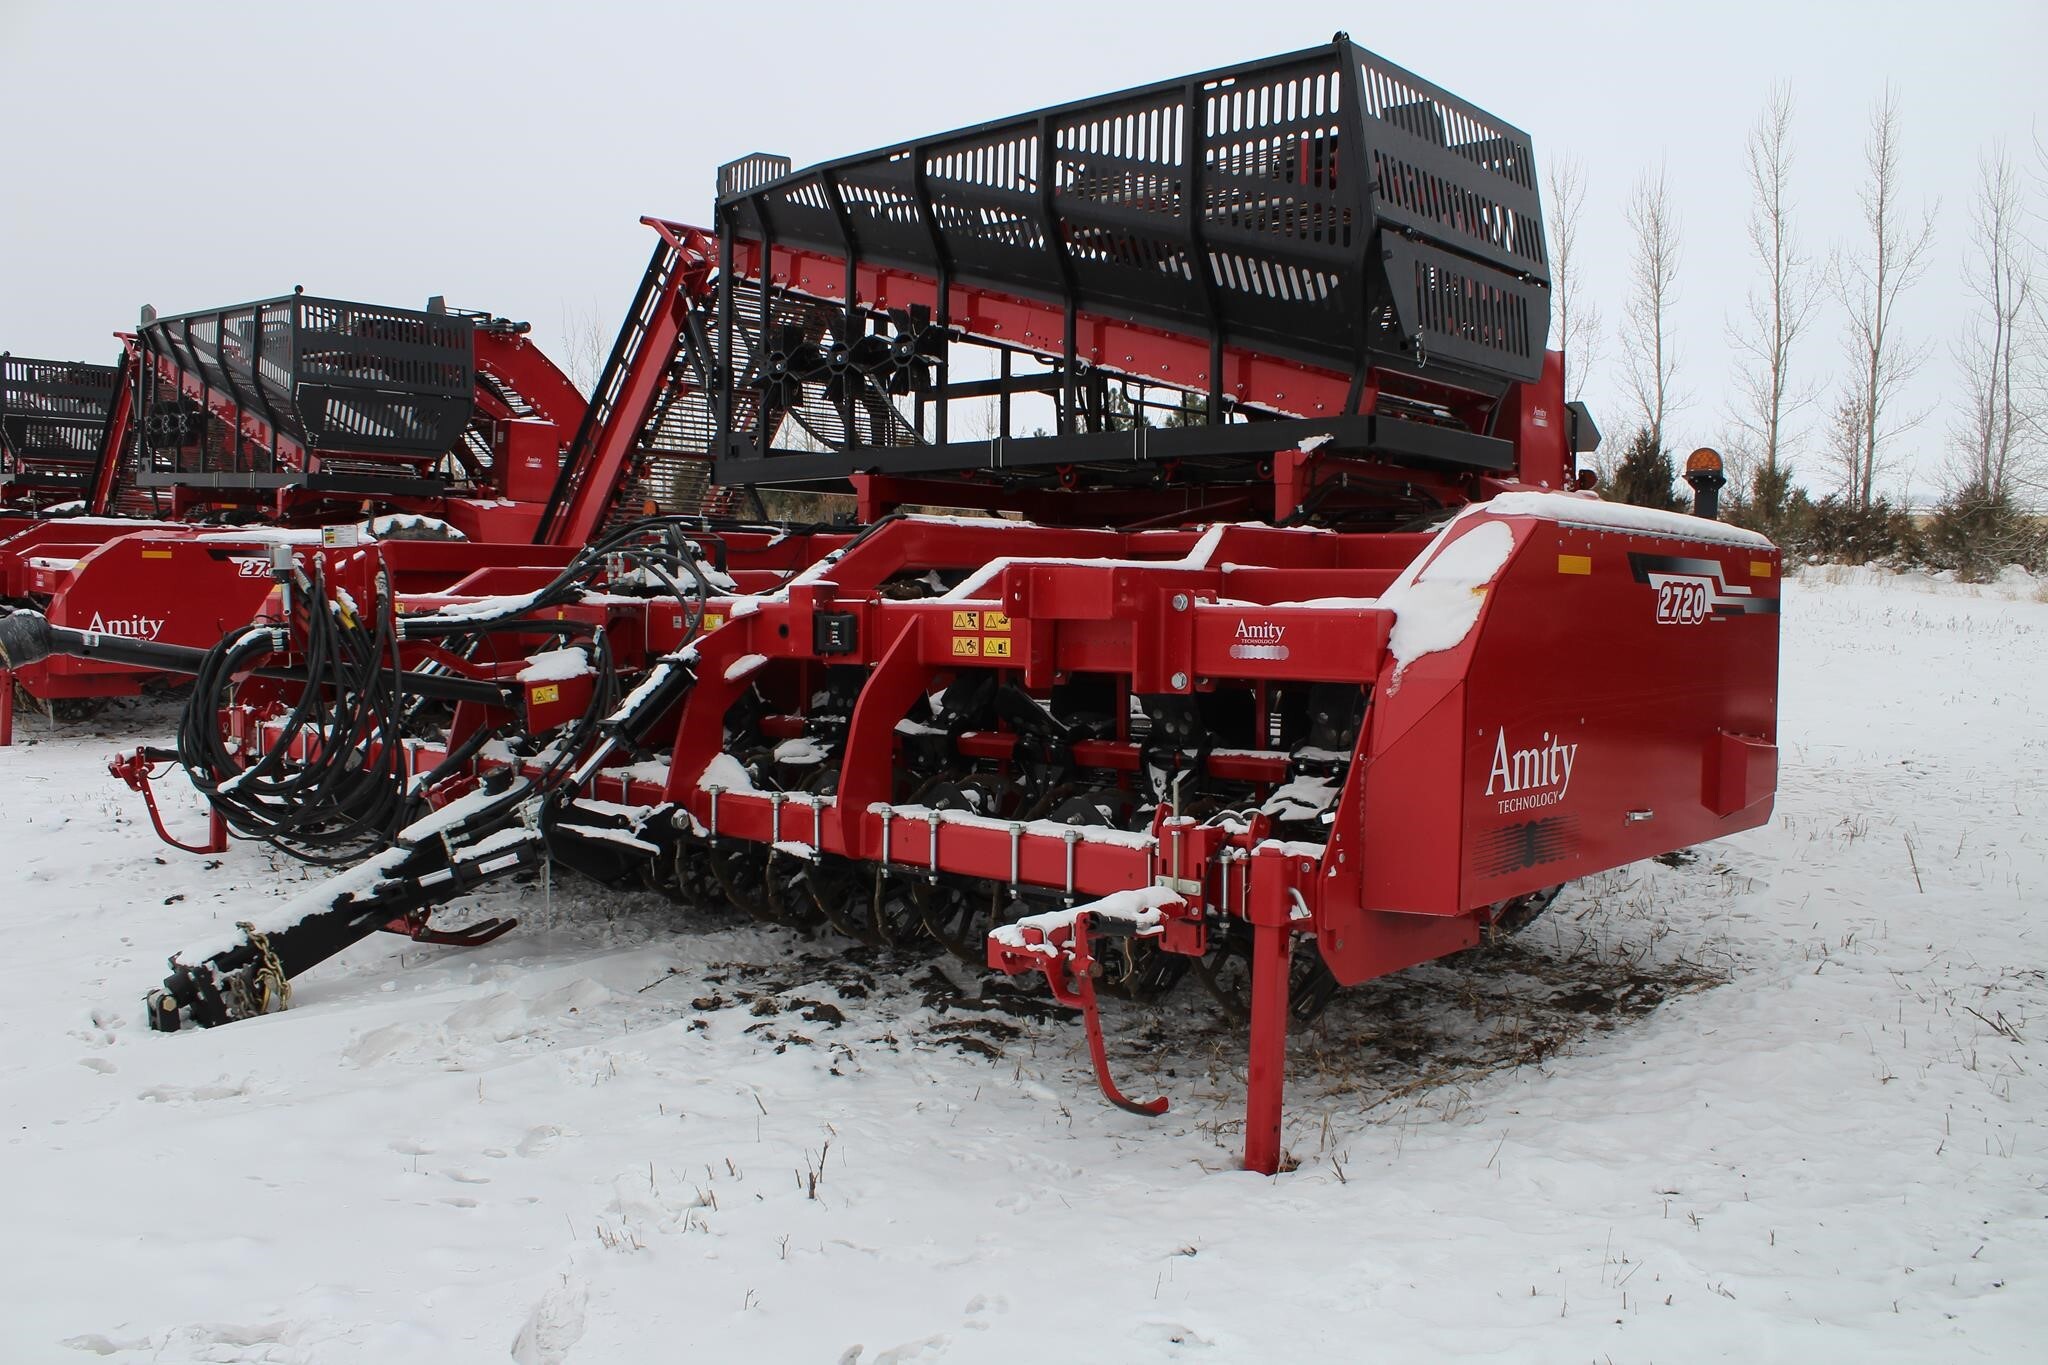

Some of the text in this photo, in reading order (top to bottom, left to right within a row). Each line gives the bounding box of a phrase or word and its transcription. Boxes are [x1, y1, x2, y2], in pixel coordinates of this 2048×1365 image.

[1658, 583, 1705, 620] 2720
[88, 611, 165, 641] Amity
[1234, 617, 1286, 644] Amity
[1485, 725, 1578, 801] Amity
[1498, 790, 1560, 815] TECHNOLOGY
